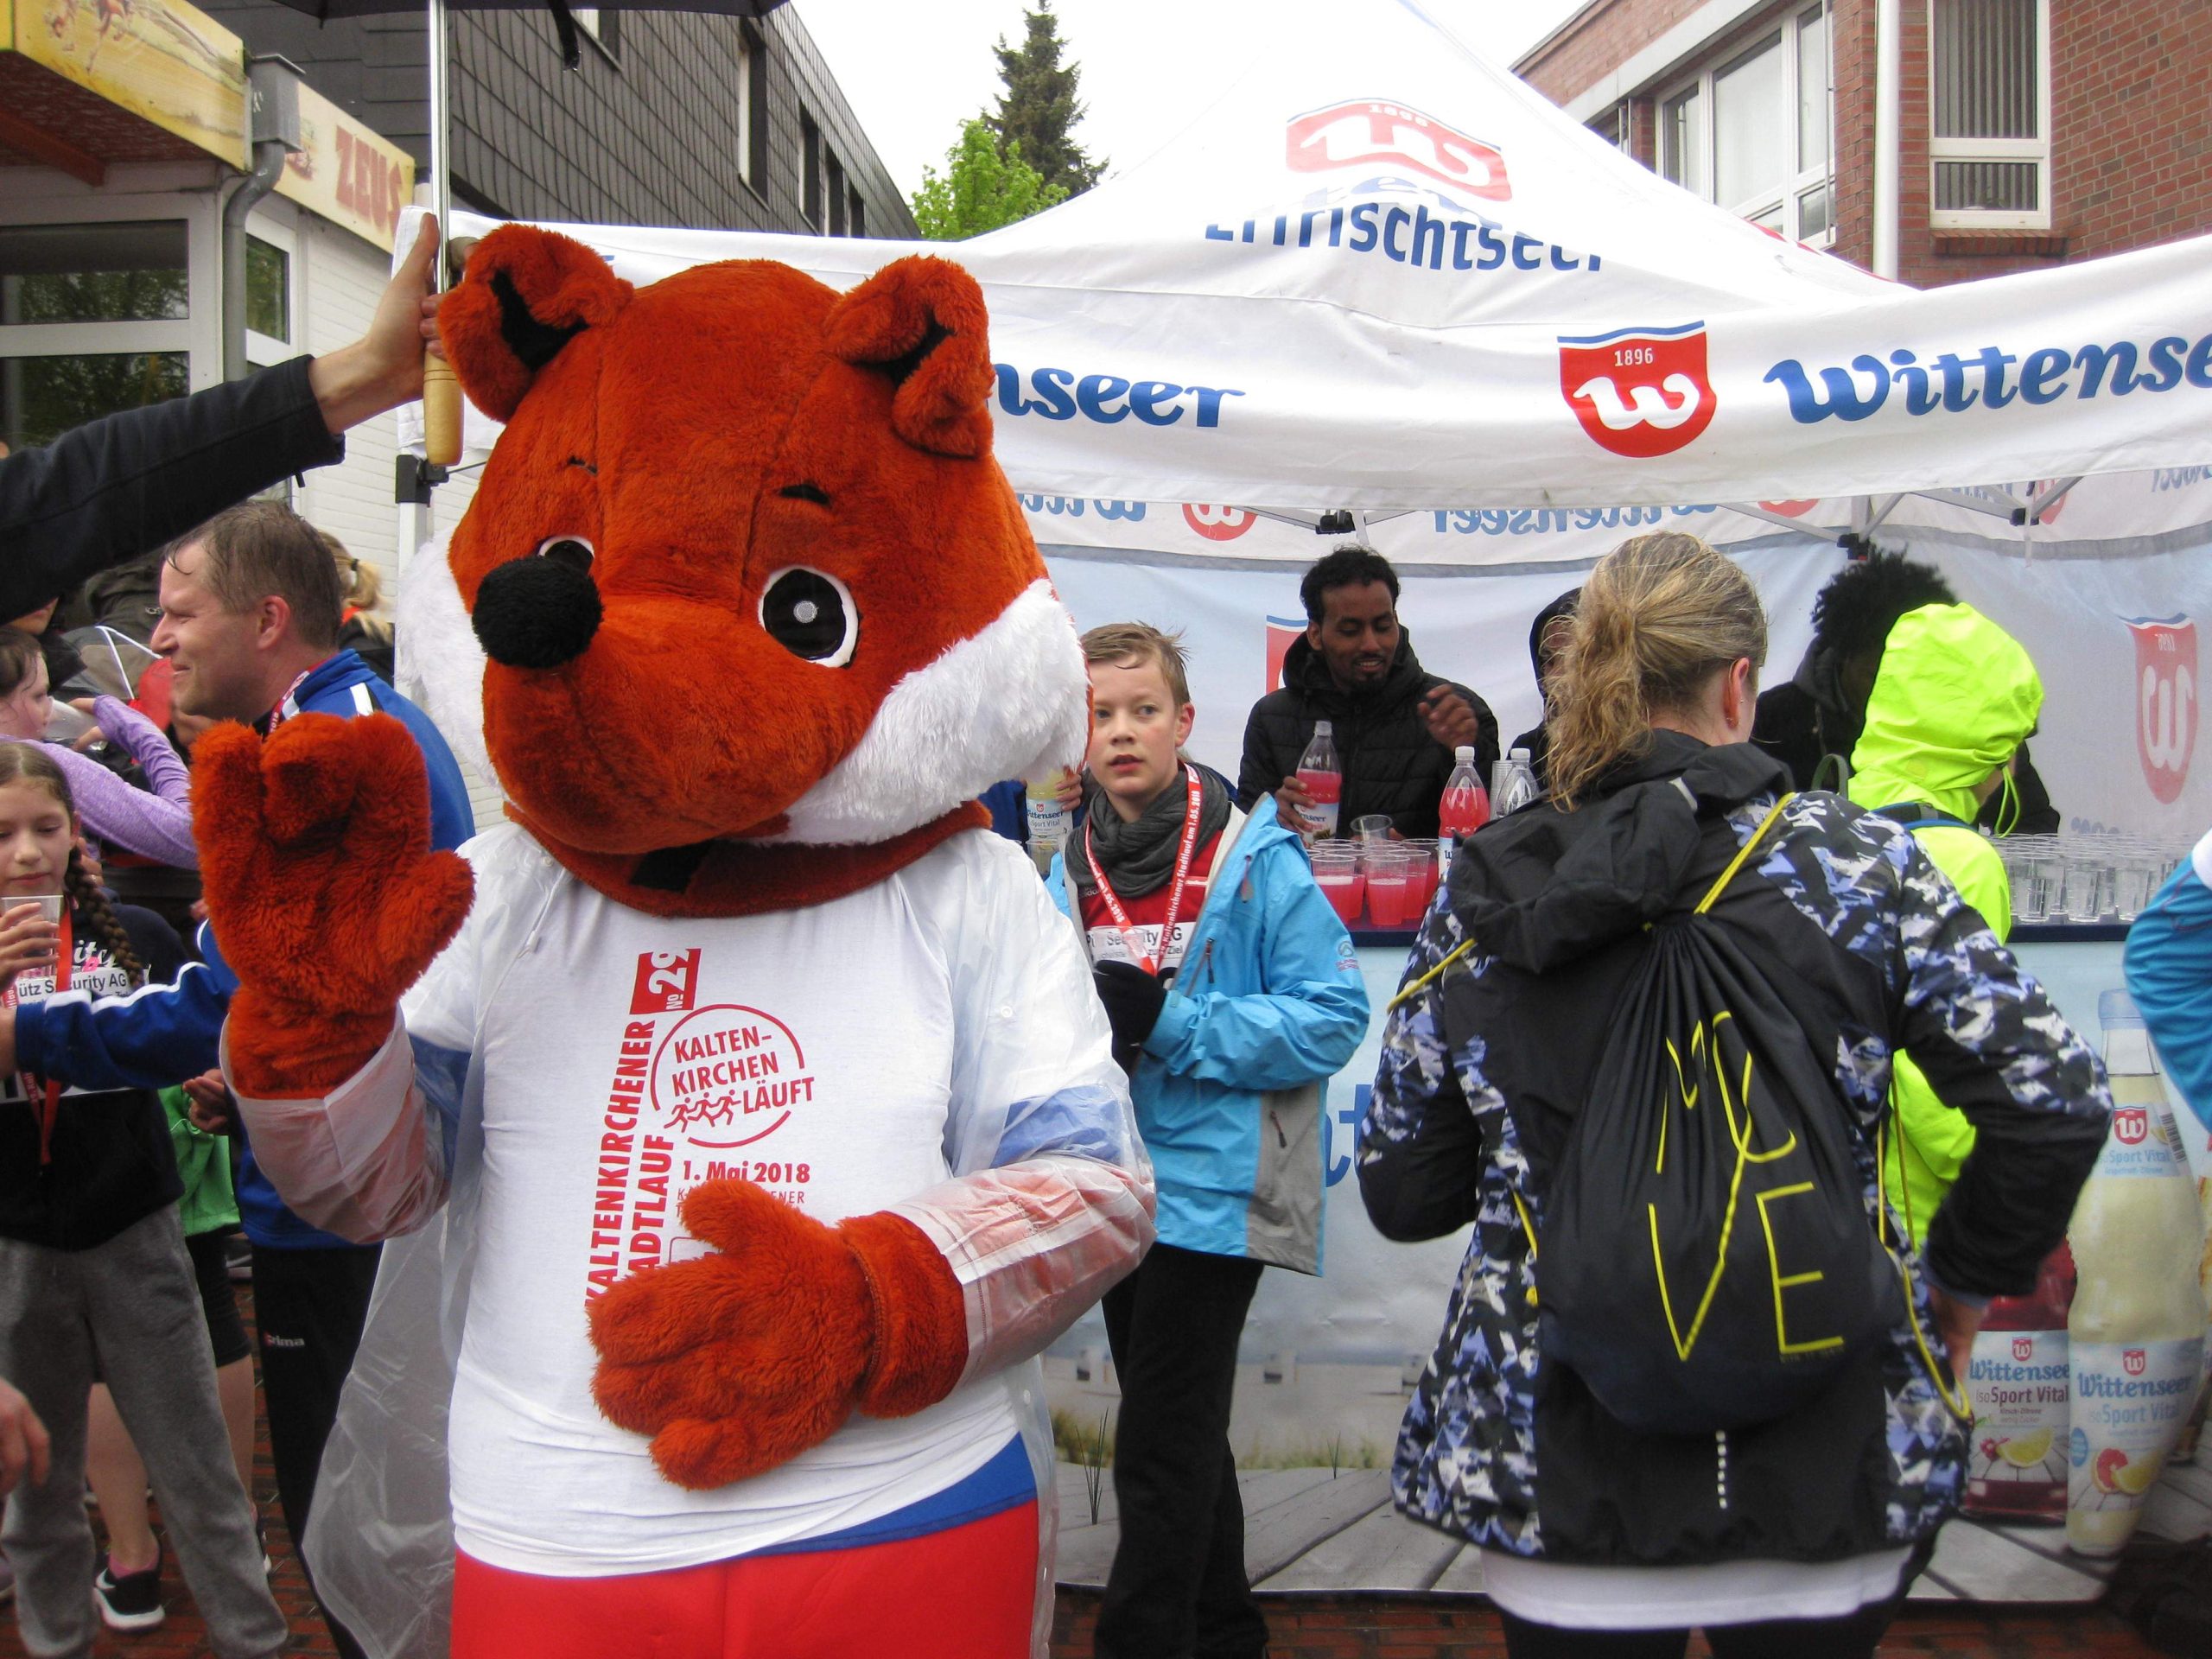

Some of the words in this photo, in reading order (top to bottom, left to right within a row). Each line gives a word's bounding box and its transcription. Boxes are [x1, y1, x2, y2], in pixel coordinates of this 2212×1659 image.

[335, 124, 403, 239] ZEUS
[1614, 347, 1654, 367] 1896
[1177, 839, 1193, 878] Stadtlauf
[109, 973, 127, 987] AG
[649, 949, 690, 995] 29
[674, 1026, 772, 1064] KALTEN-
[671, 1051, 779, 1097] KIRCHEN
[743, 1077, 815, 1115] LÄUFT
[683, 1160, 701, 1180] 1.
[706, 1160, 748, 1180] Mai
[753, 1161, 810, 1184] 2018
[2037, 1384, 2069, 1403] Vital
